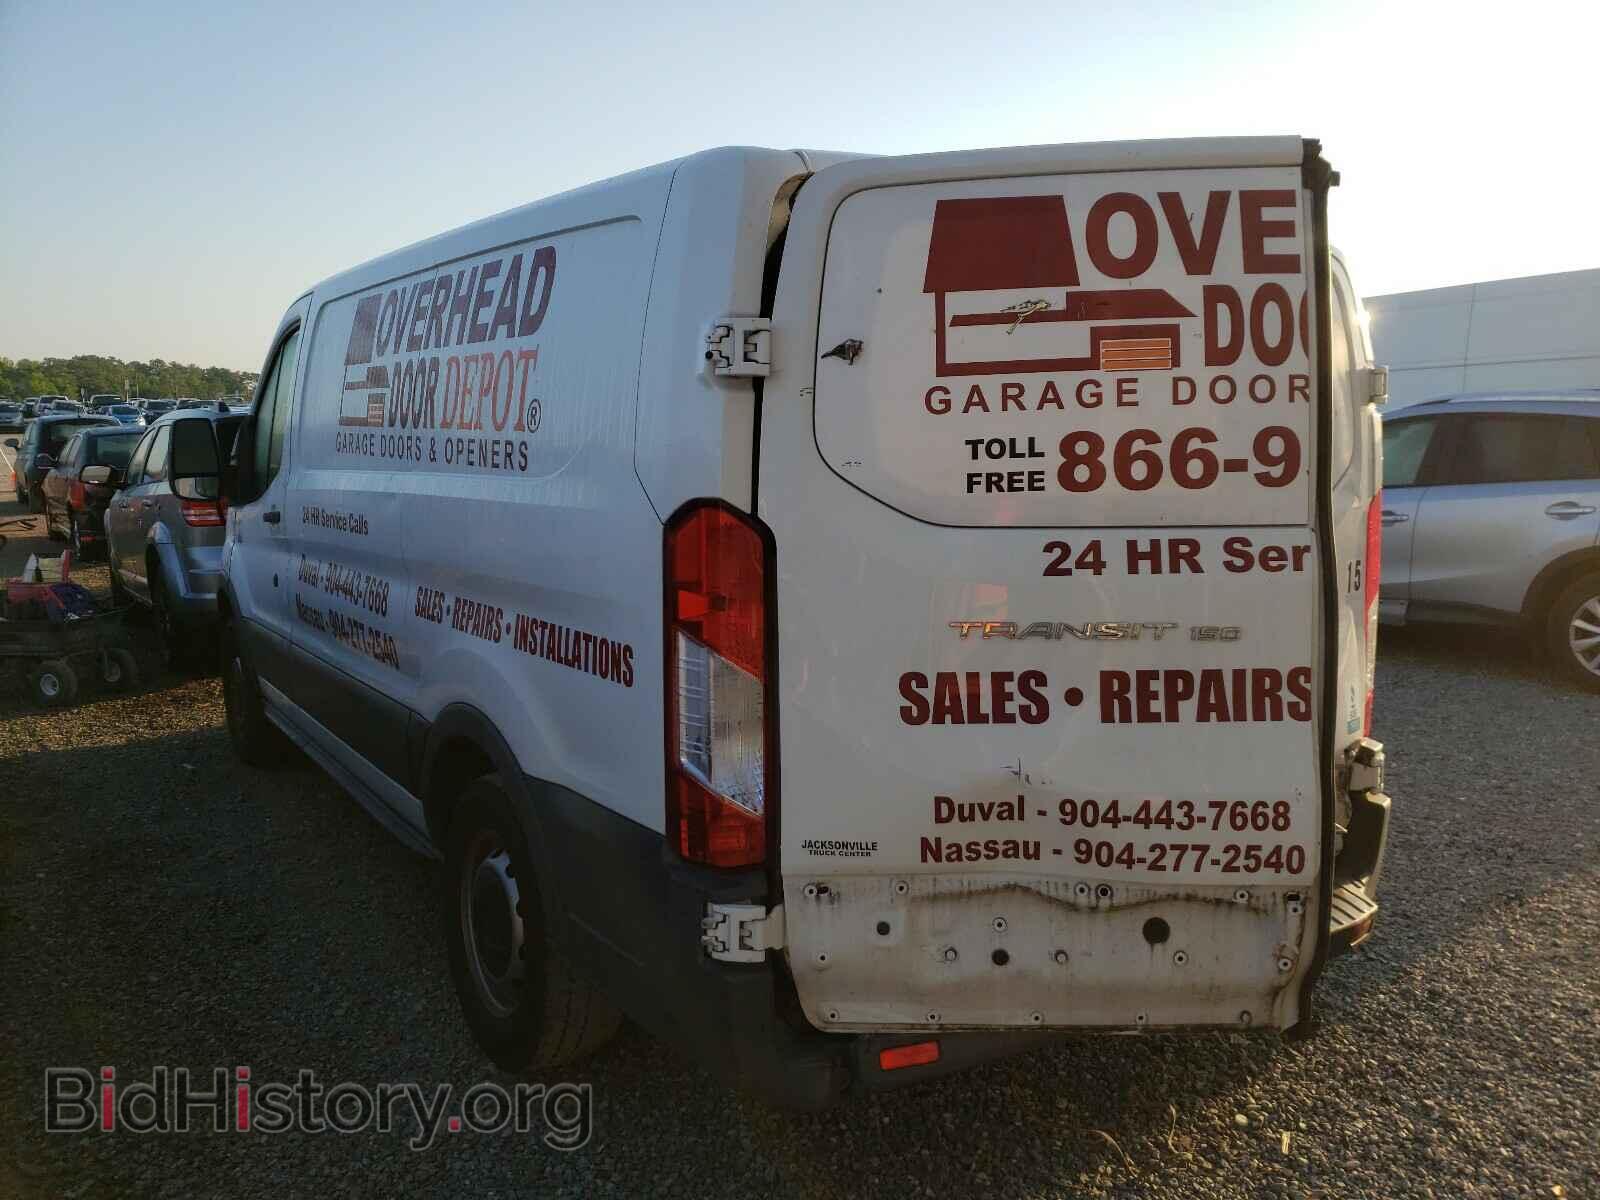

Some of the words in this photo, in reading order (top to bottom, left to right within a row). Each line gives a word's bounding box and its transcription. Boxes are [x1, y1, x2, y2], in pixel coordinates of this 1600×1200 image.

[1085, 189, 1301, 279] OVE
[377, 246, 556, 356] OVERHEAD
[1203, 282, 1309, 367] DO
[387, 357, 440, 429] DOOR
[924, 377, 1139, 415] GARAGE
[1172, 374, 1310, 406] DOOR
[336, 432, 375, 457] GARAGE
[380, 434, 422, 461] DOORS
[429, 440, 437, 462] &
[445, 438, 528, 472] OPENERS
[965, 436, 1045, 460] TOLL
[1057, 426, 1301, 492] 866-9
[965, 470, 1045, 493] FREE
[311, 506, 320, 526] HR
[321, 509, 347, 531] Service
[349, 513, 369, 535] Calls
[1042, 540, 1106, 576] 24
[1126, 538, 1204, 575] HR
[1222, 537, 1311, 574] Ser
[415, 586, 445, 624] SALES
[452, 597, 503, 643] REPAIRS
[513, 613, 634, 687] INSTALLATIONS
[949, 622, 1177, 641] TRANSIT
[1190, 626, 1241, 642] 150
[898, 670, 1050, 726] SALES
[1100, 666, 1312, 724] REPAIRS
[934, 795, 1024, 824] Duval
[1059, 798, 1291, 833] 904-443-7668
[801, 839, 878, 851] JACKSONVILLE
[920, 837, 1041, 864] Nassau
[1074, 838, 1306, 875] 904-277-2540
